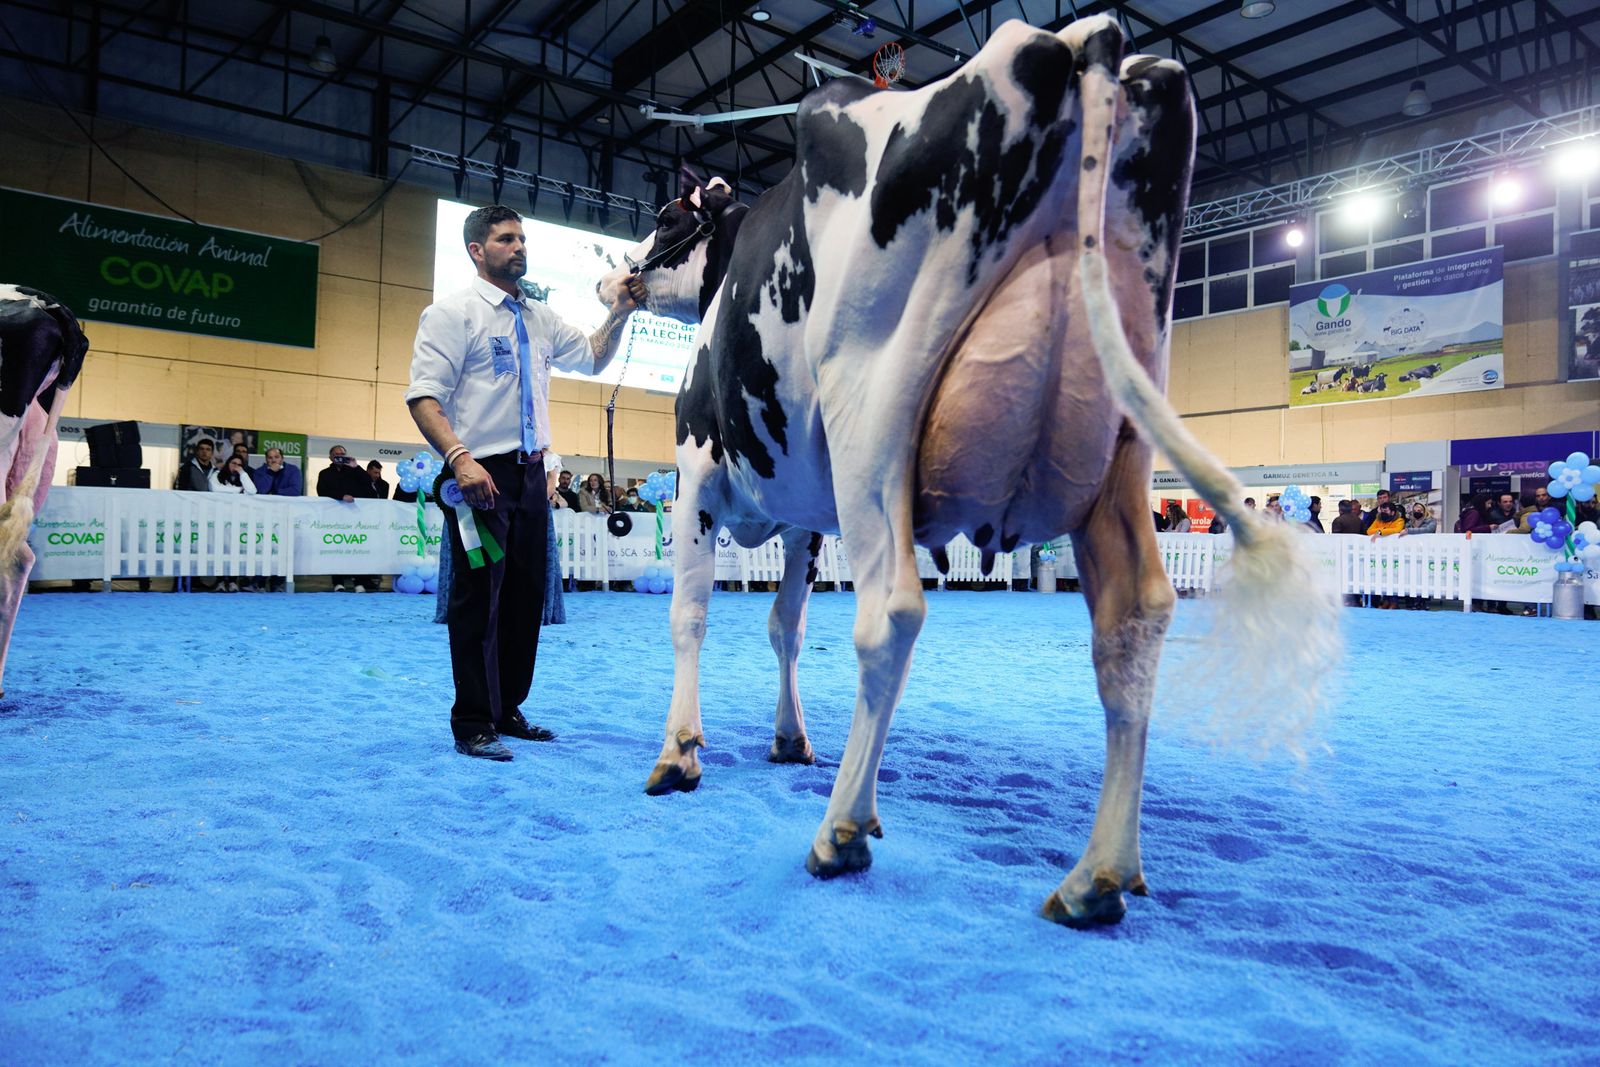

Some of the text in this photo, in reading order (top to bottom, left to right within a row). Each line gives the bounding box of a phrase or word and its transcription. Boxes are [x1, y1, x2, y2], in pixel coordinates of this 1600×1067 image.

[58, 211, 273, 268] Alimentación Animal
[1393, 269, 1434, 281] Plataforma
[1447, 258, 1493, 272] integración
[100, 256, 234, 299] COVAP
[1402, 277, 1430, 289] gestión
[1432, 275, 1442, 283] de
[1443, 272, 1465, 281] datos
[1466, 267, 1490, 277] online
[88, 297, 241, 328] garantía de futuro
[681, 324, 695, 332] de
[1316, 318, 1352, 331] Gando
[1390, 325, 1421, 336] BIG DATA
[653, 328, 695, 343] LECHE
[263, 440, 301, 455] SOMOS
[379, 448, 402, 456] COVAP
[47, 532, 105, 545] COVAP
[322, 533, 368, 545] COVAP
[400, 534, 442, 545] COAP
[620, 548, 638, 557] SCA
[1497, 565, 1539, 576] COVAP
